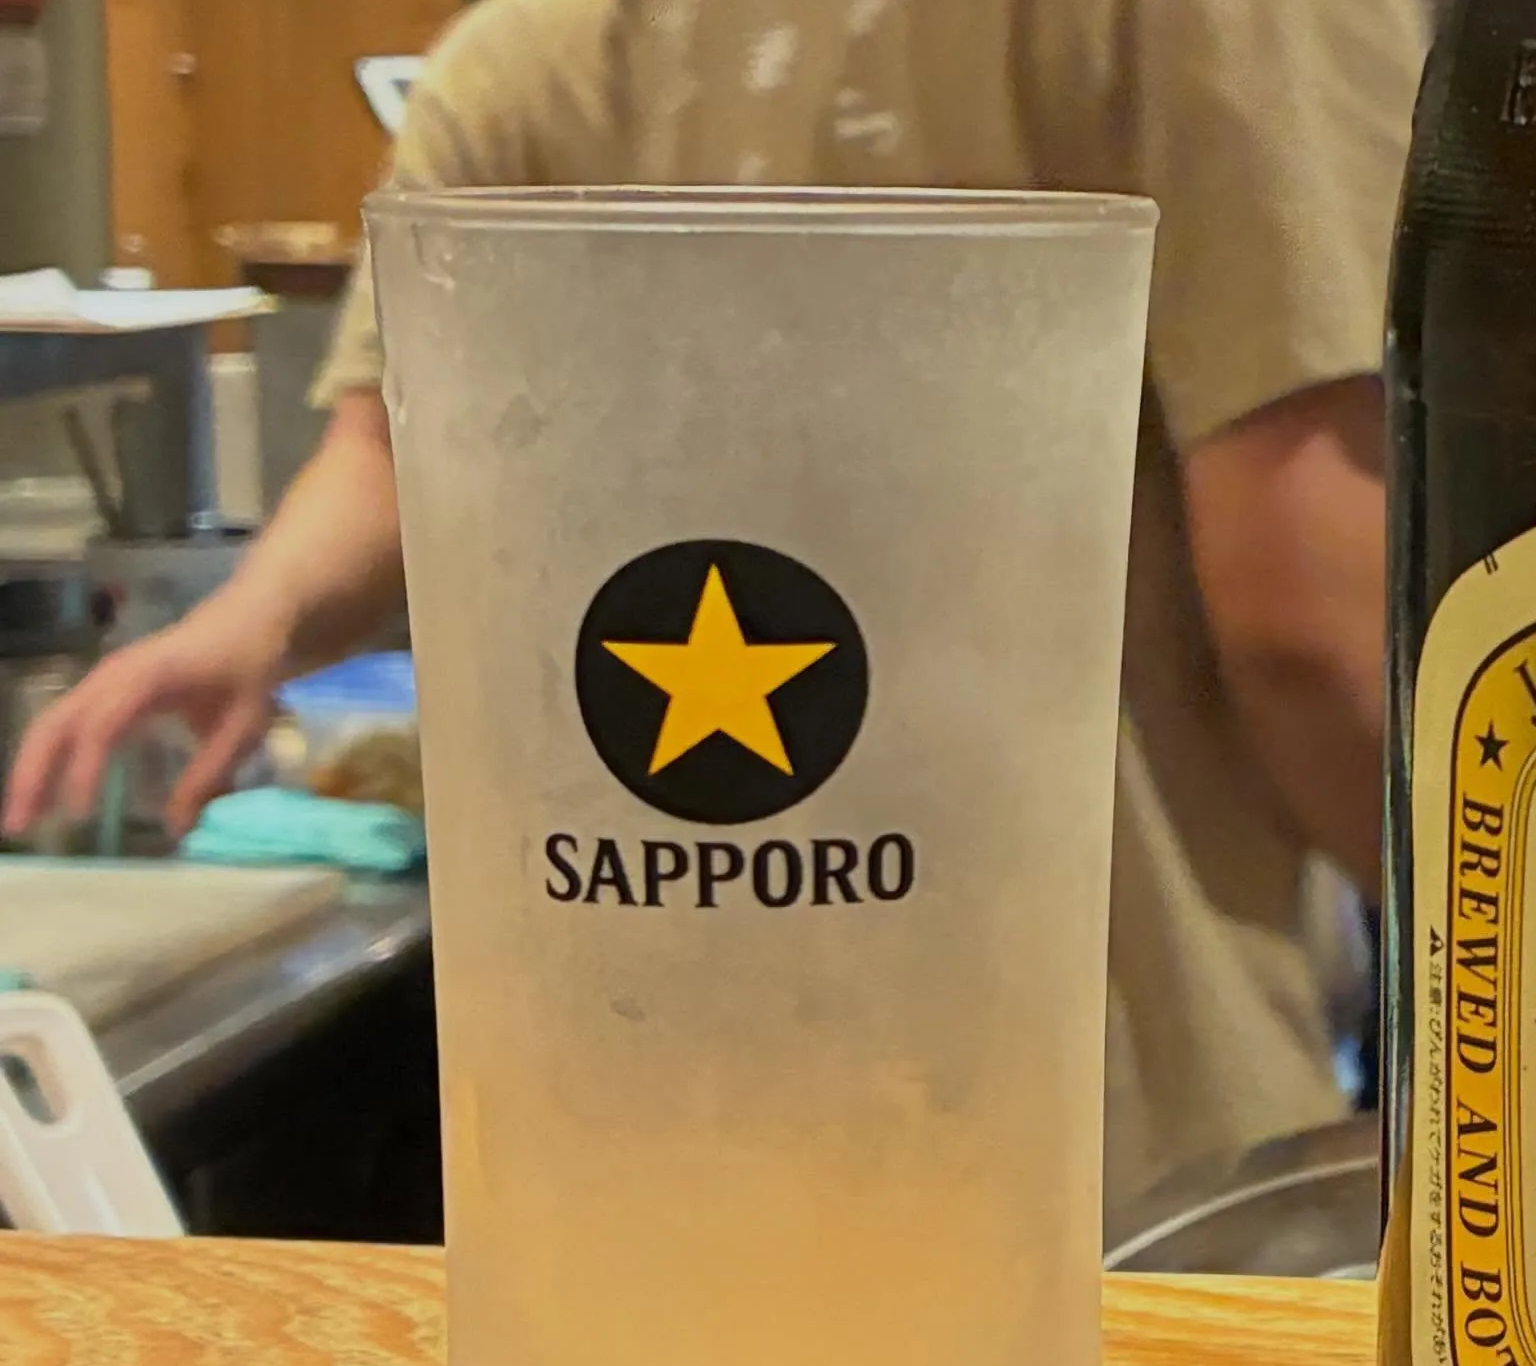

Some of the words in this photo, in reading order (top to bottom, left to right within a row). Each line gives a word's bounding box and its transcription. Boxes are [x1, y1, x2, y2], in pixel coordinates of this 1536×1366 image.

[546, 833, 914, 908] SAPPORO
[1456, 791, 1505, 1074] BREWED
[1456, 1095, 1501, 1238] AND
